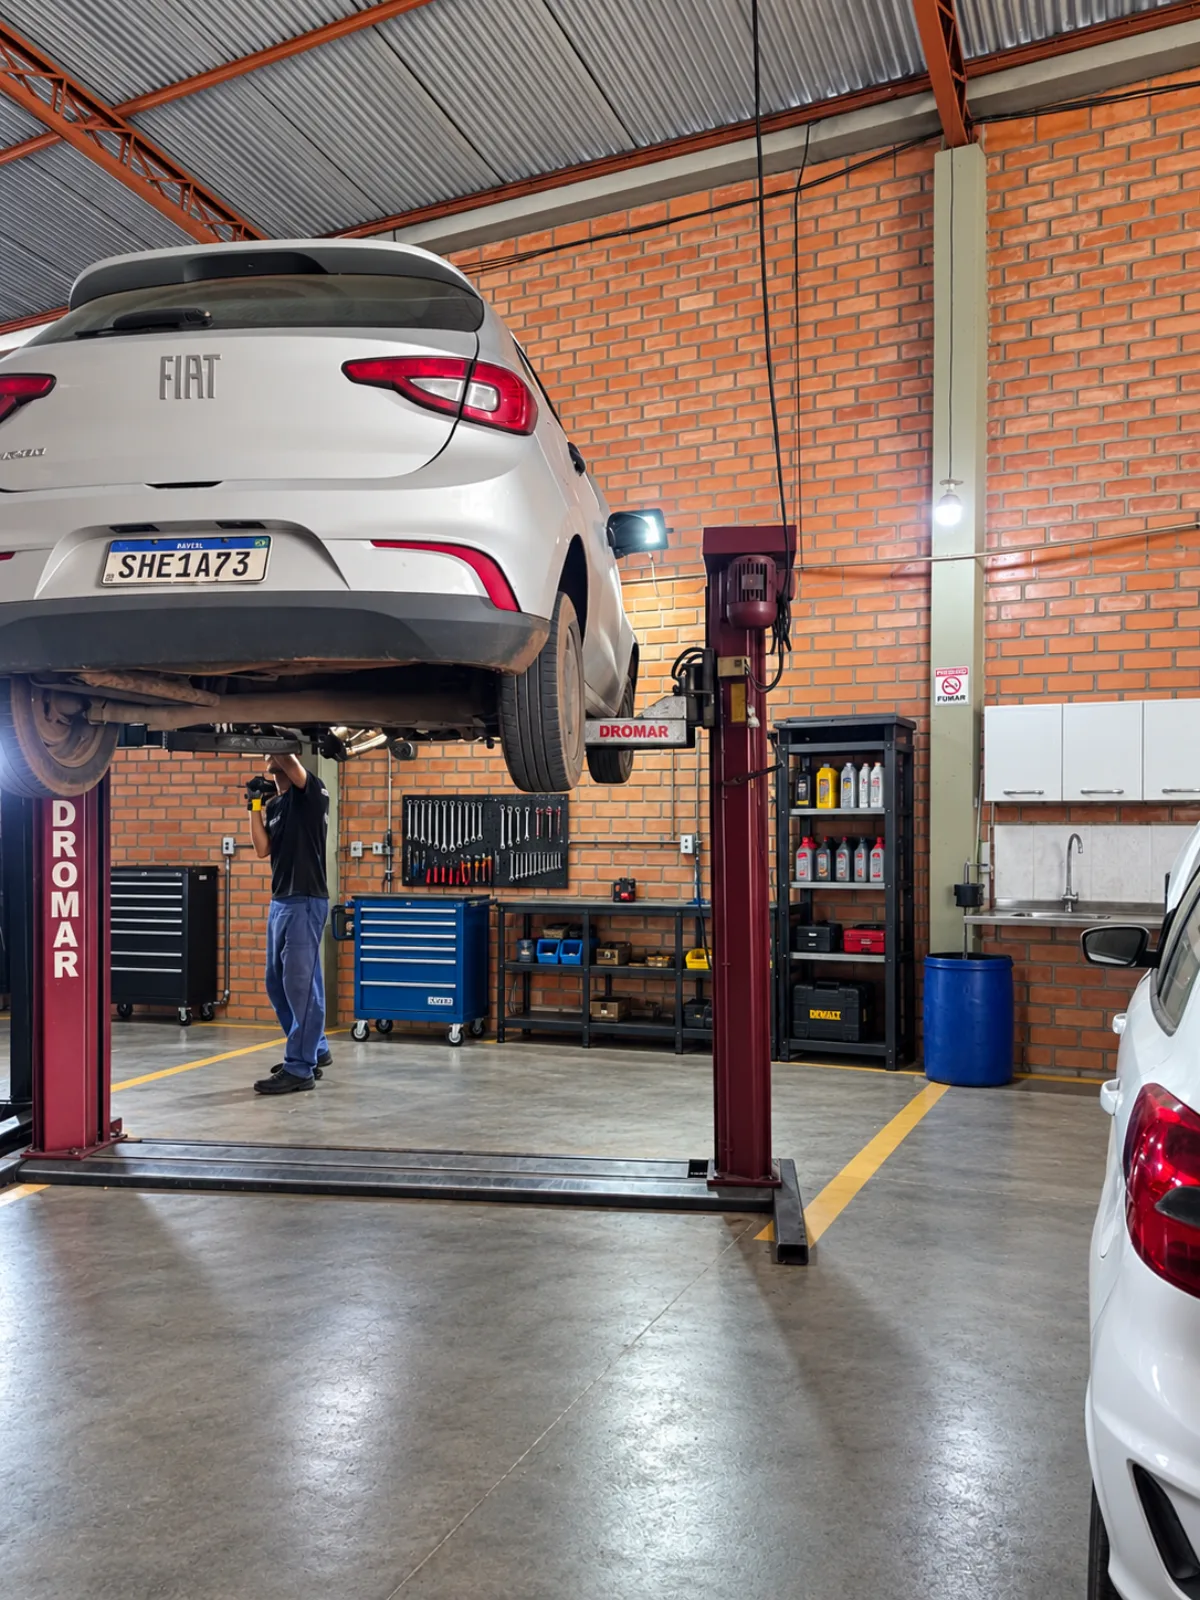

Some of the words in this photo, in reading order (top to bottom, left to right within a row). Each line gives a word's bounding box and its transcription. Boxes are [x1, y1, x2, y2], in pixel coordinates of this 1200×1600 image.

[159, 354, 221, 400] FIAT
[118, 551, 251, 579] SHE1A73
[937, 694, 966, 702] FUMAR
[600, 725, 669, 738] DROMAR
[51, 800, 79, 978] DROMAR
